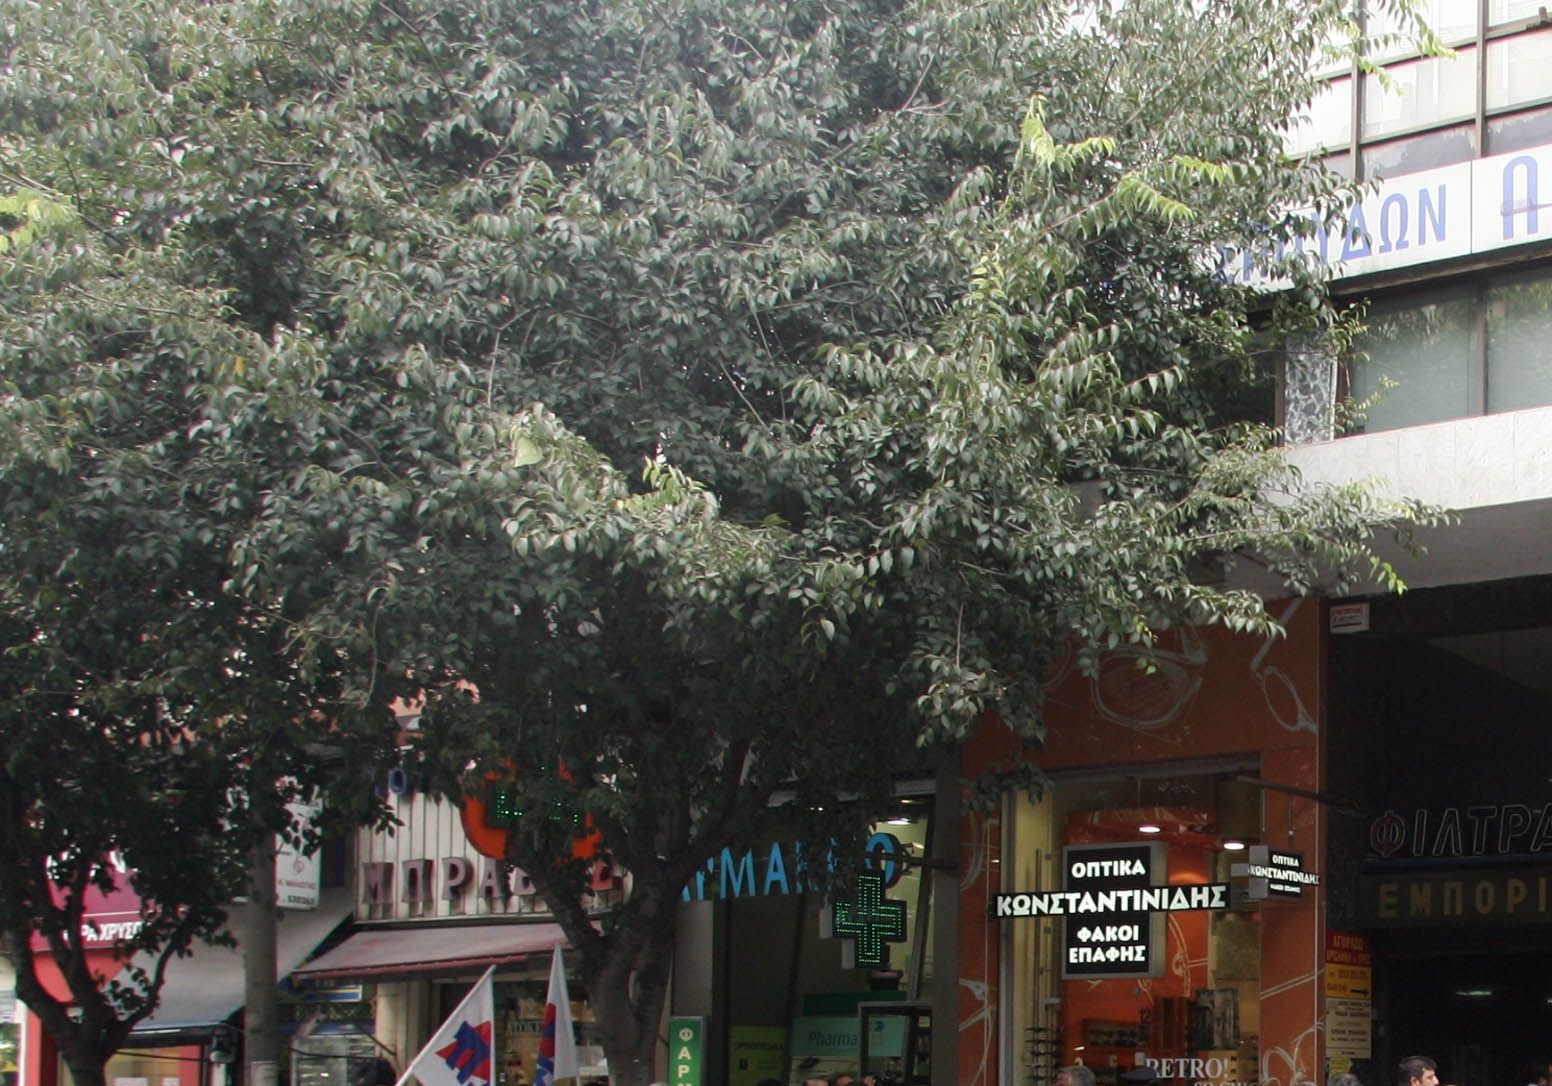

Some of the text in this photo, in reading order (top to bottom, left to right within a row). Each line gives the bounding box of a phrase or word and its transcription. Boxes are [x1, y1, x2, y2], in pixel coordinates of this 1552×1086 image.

[1071, 858, 1146, 878] ΟΠΤΙΚΑ
[996, 884, 1227, 917] ΚΩΝΣΤΑΝΤΙΝΙΔΗΣ
[1076, 925, 1139, 942] ΦΑΚΟΙ
[1069, 945, 1146, 964] ΕΠΑΦΗΣ
